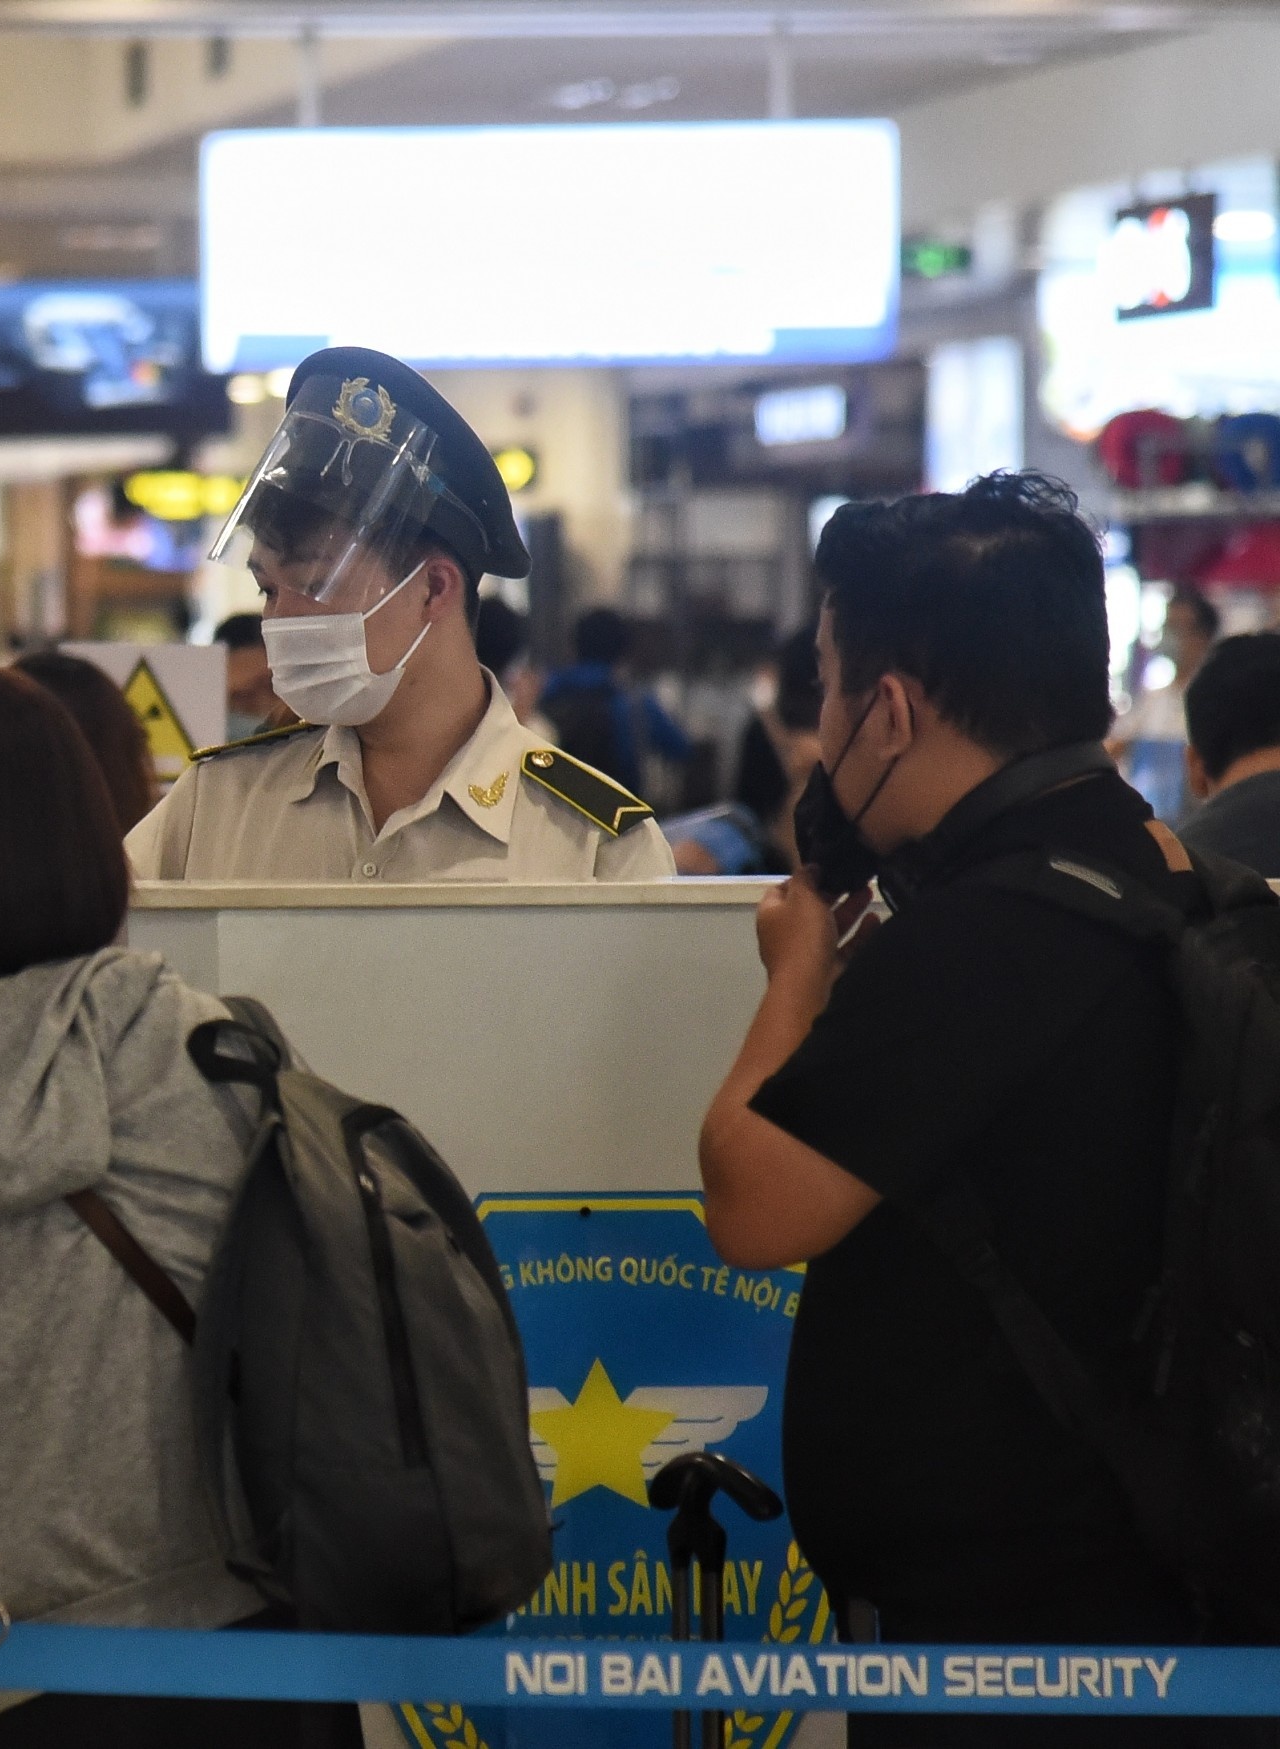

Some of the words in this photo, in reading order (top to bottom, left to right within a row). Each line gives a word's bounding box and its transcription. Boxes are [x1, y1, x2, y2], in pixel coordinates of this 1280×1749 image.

[519, 1252, 613, 1289] KHÔNG
[620, 1253, 693, 1288] QUỐC
[701, 1264, 730, 1295] TẾ
[733, 1273, 781, 1313] NỘI
[517, 1561, 596, 1616] NH
[607, 1549, 673, 1616] SÂN
[692, 1561, 762, 1616] AY
[505, 1653, 587, 1696] NOI
[601, 1653, 681, 1697] BAI
[696, 1653, 928, 1697] AVIATION
[943, 1655, 1177, 1698] SECURITY
